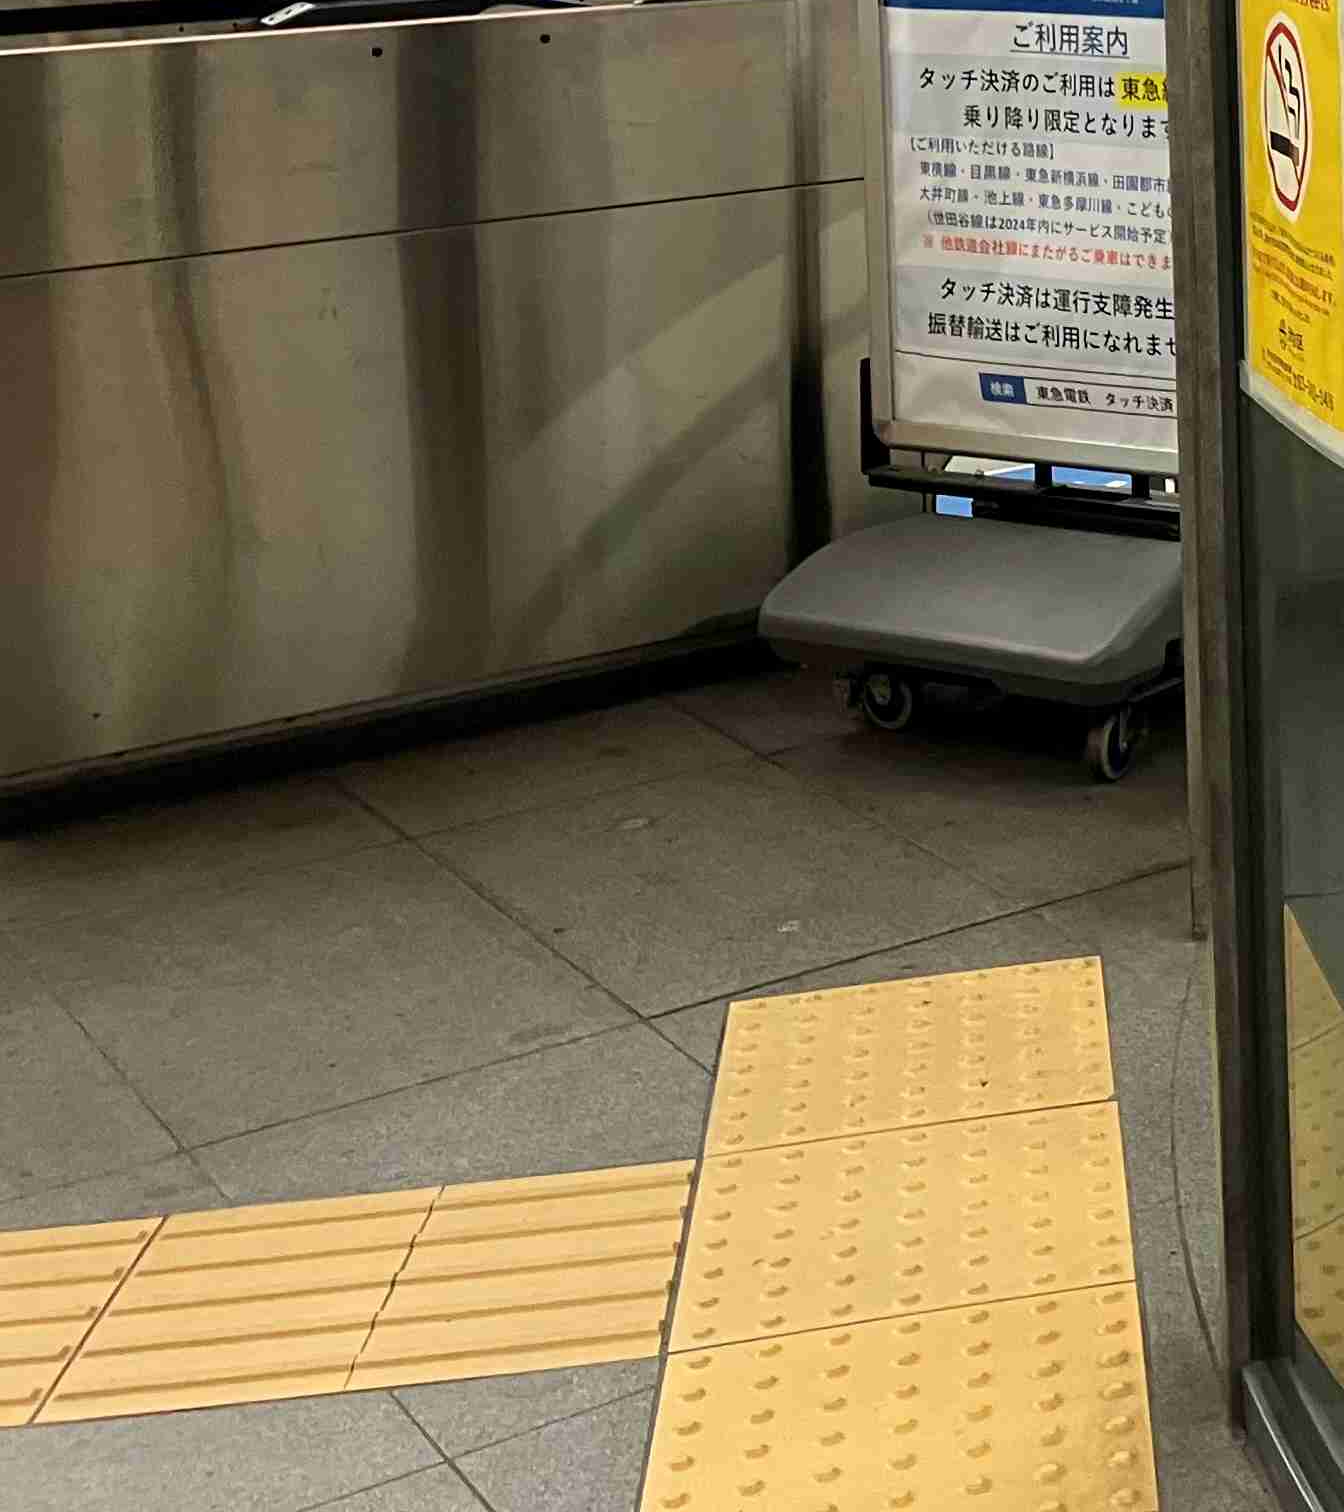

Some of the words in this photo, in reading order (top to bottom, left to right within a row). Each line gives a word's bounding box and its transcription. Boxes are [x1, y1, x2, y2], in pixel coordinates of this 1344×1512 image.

[1014, 21, 1129, 56] ご利用案内
[919, 68, 1169, 103] タッチ決済のご利用は東急
[911, 136, 1055, 161] 【ご利用いただける路線】
[919, 160, 1170, 193] 東横線・目黒線・東急新横浜線・田園都市
[941, 277, 1175, 320] タッチ決済は運行支障発生
[1037, 385, 1090, 406] 東急電鉄
[1106, 391, 1174, 412] タッチ決済
